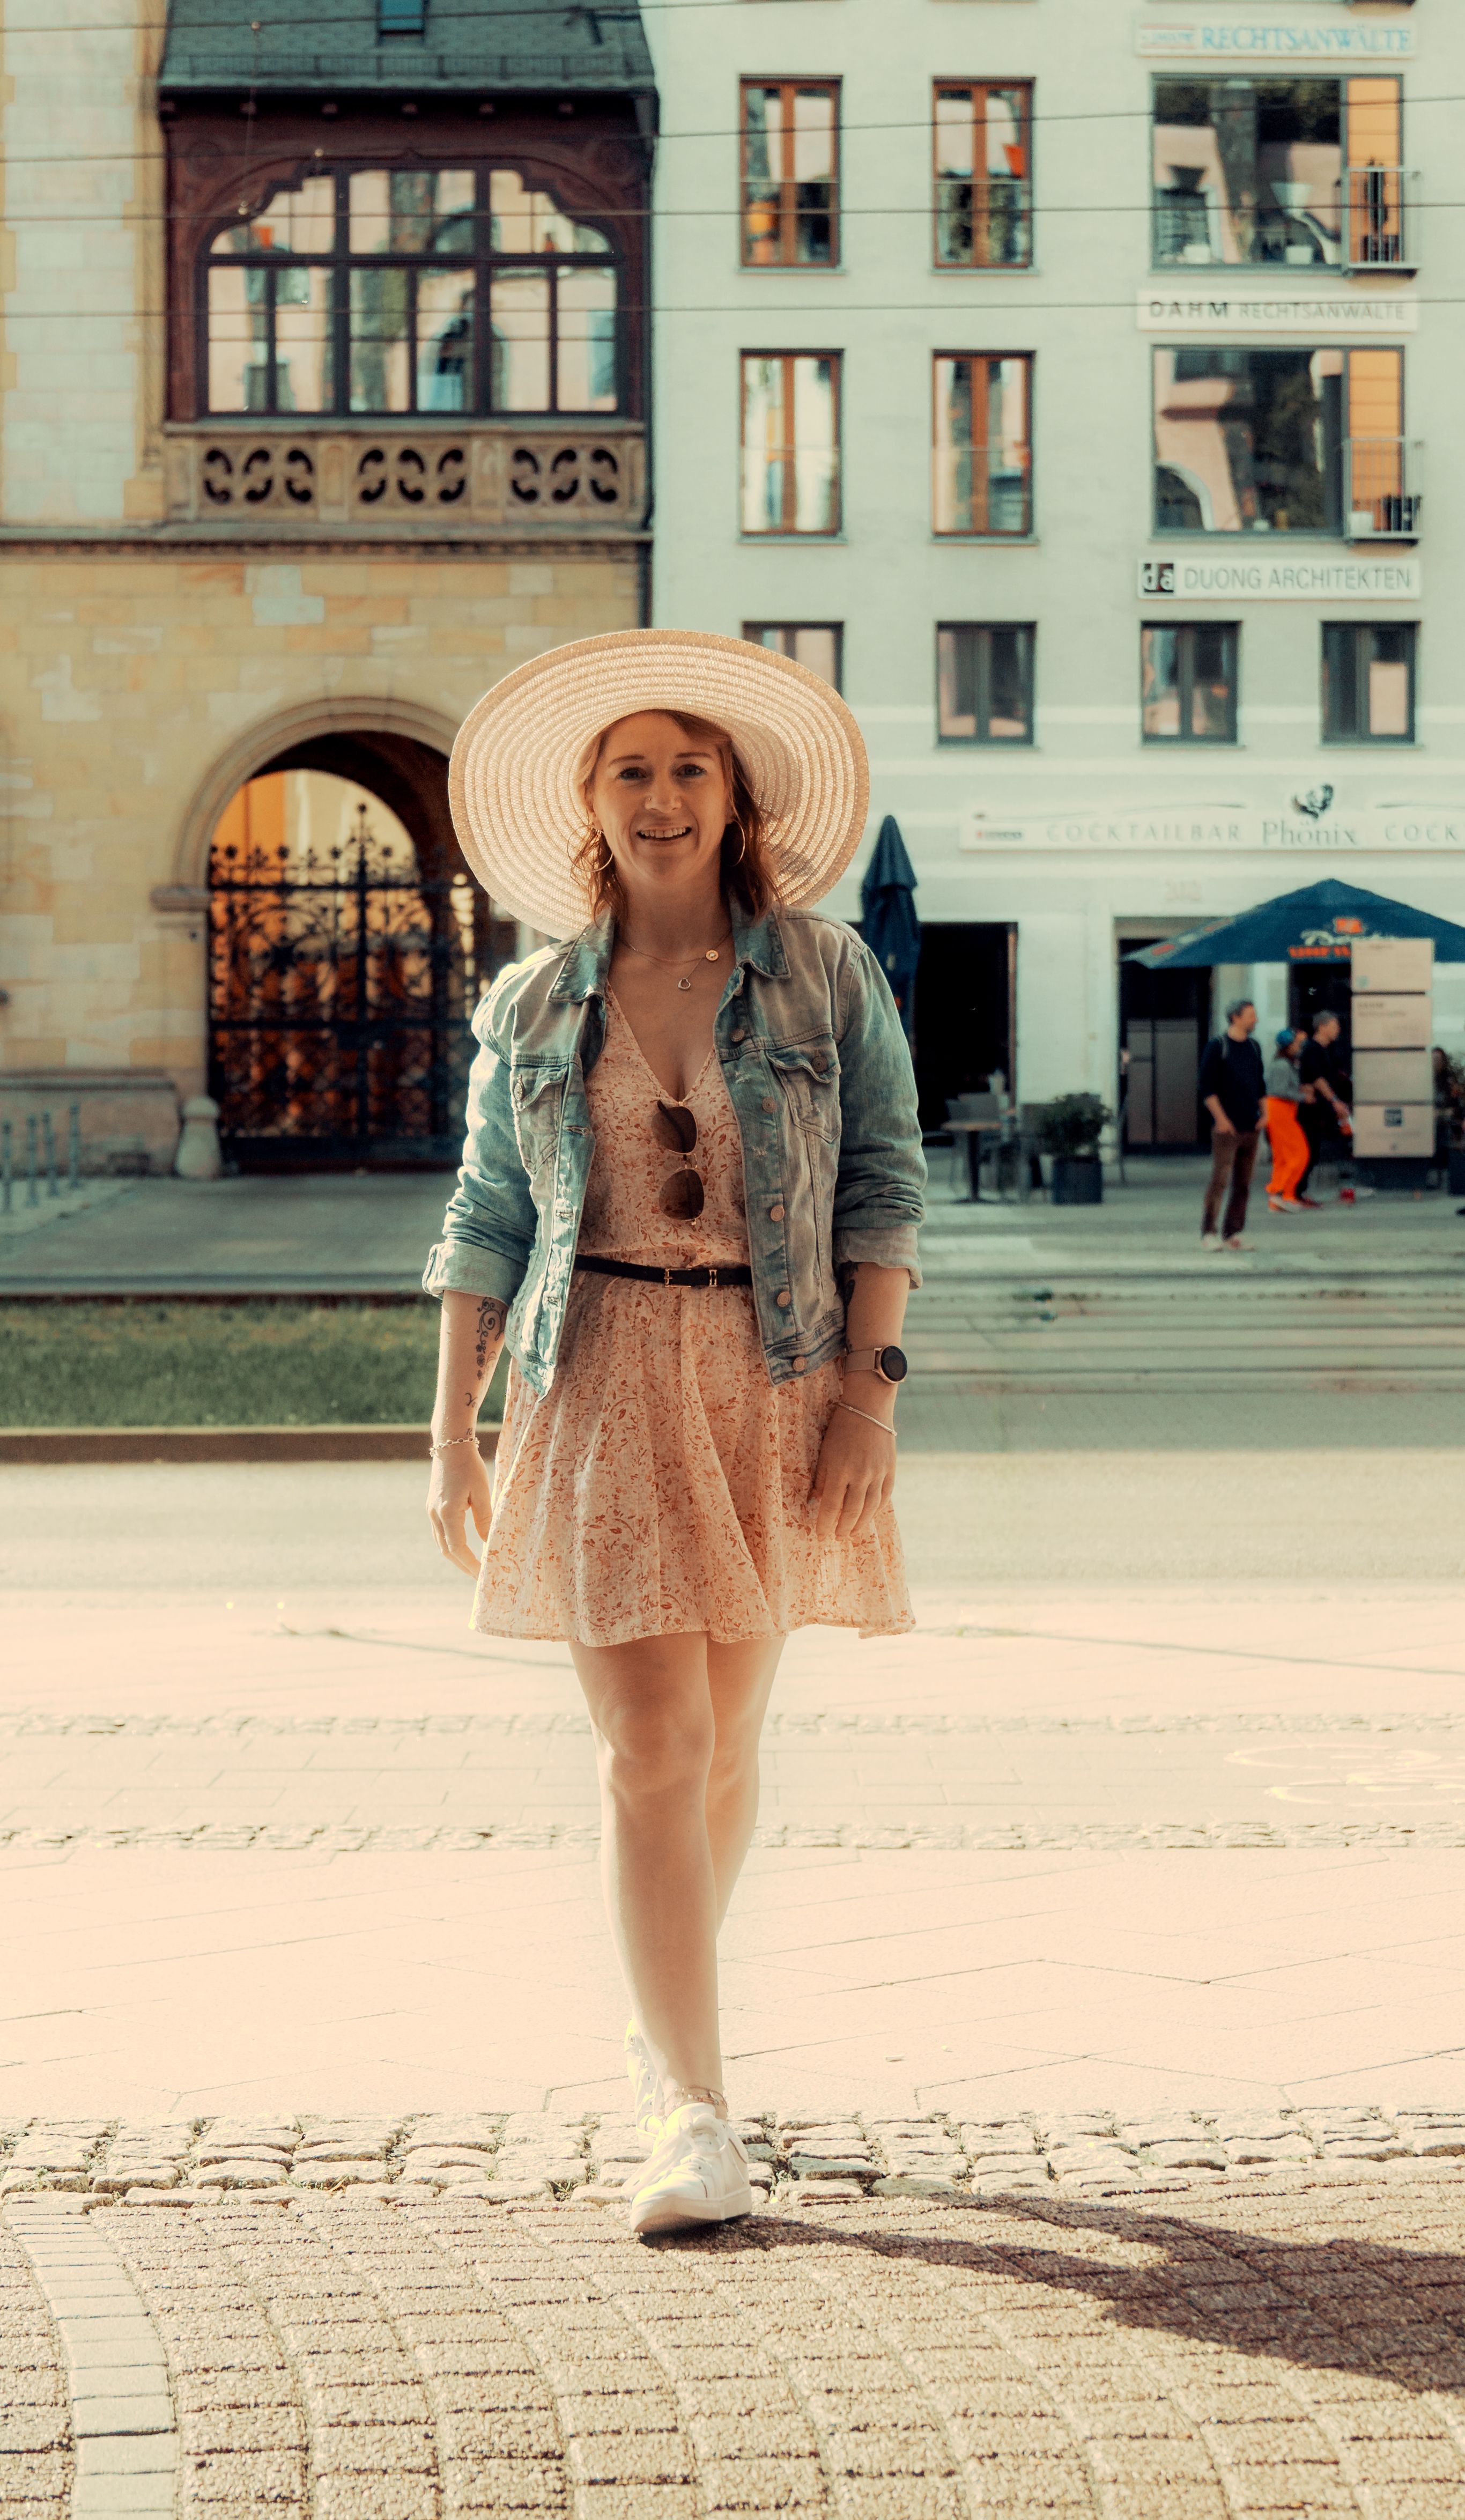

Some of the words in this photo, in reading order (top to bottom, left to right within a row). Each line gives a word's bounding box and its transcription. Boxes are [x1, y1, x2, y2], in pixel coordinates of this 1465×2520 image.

[1201, 24, 1411, 52] RECHTSANWÄLTE
[1149, 301, 1229, 319] DAHM
[1185, 568, 1261, 590] DUONG
[1268, 568, 1411, 590] ARCHITEKTEN
[1046, 823, 1242, 843] COCKTAILBAR
[1262, 819, 1357, 846] Phönix
[1384, 823, 1458, 843] COCK
